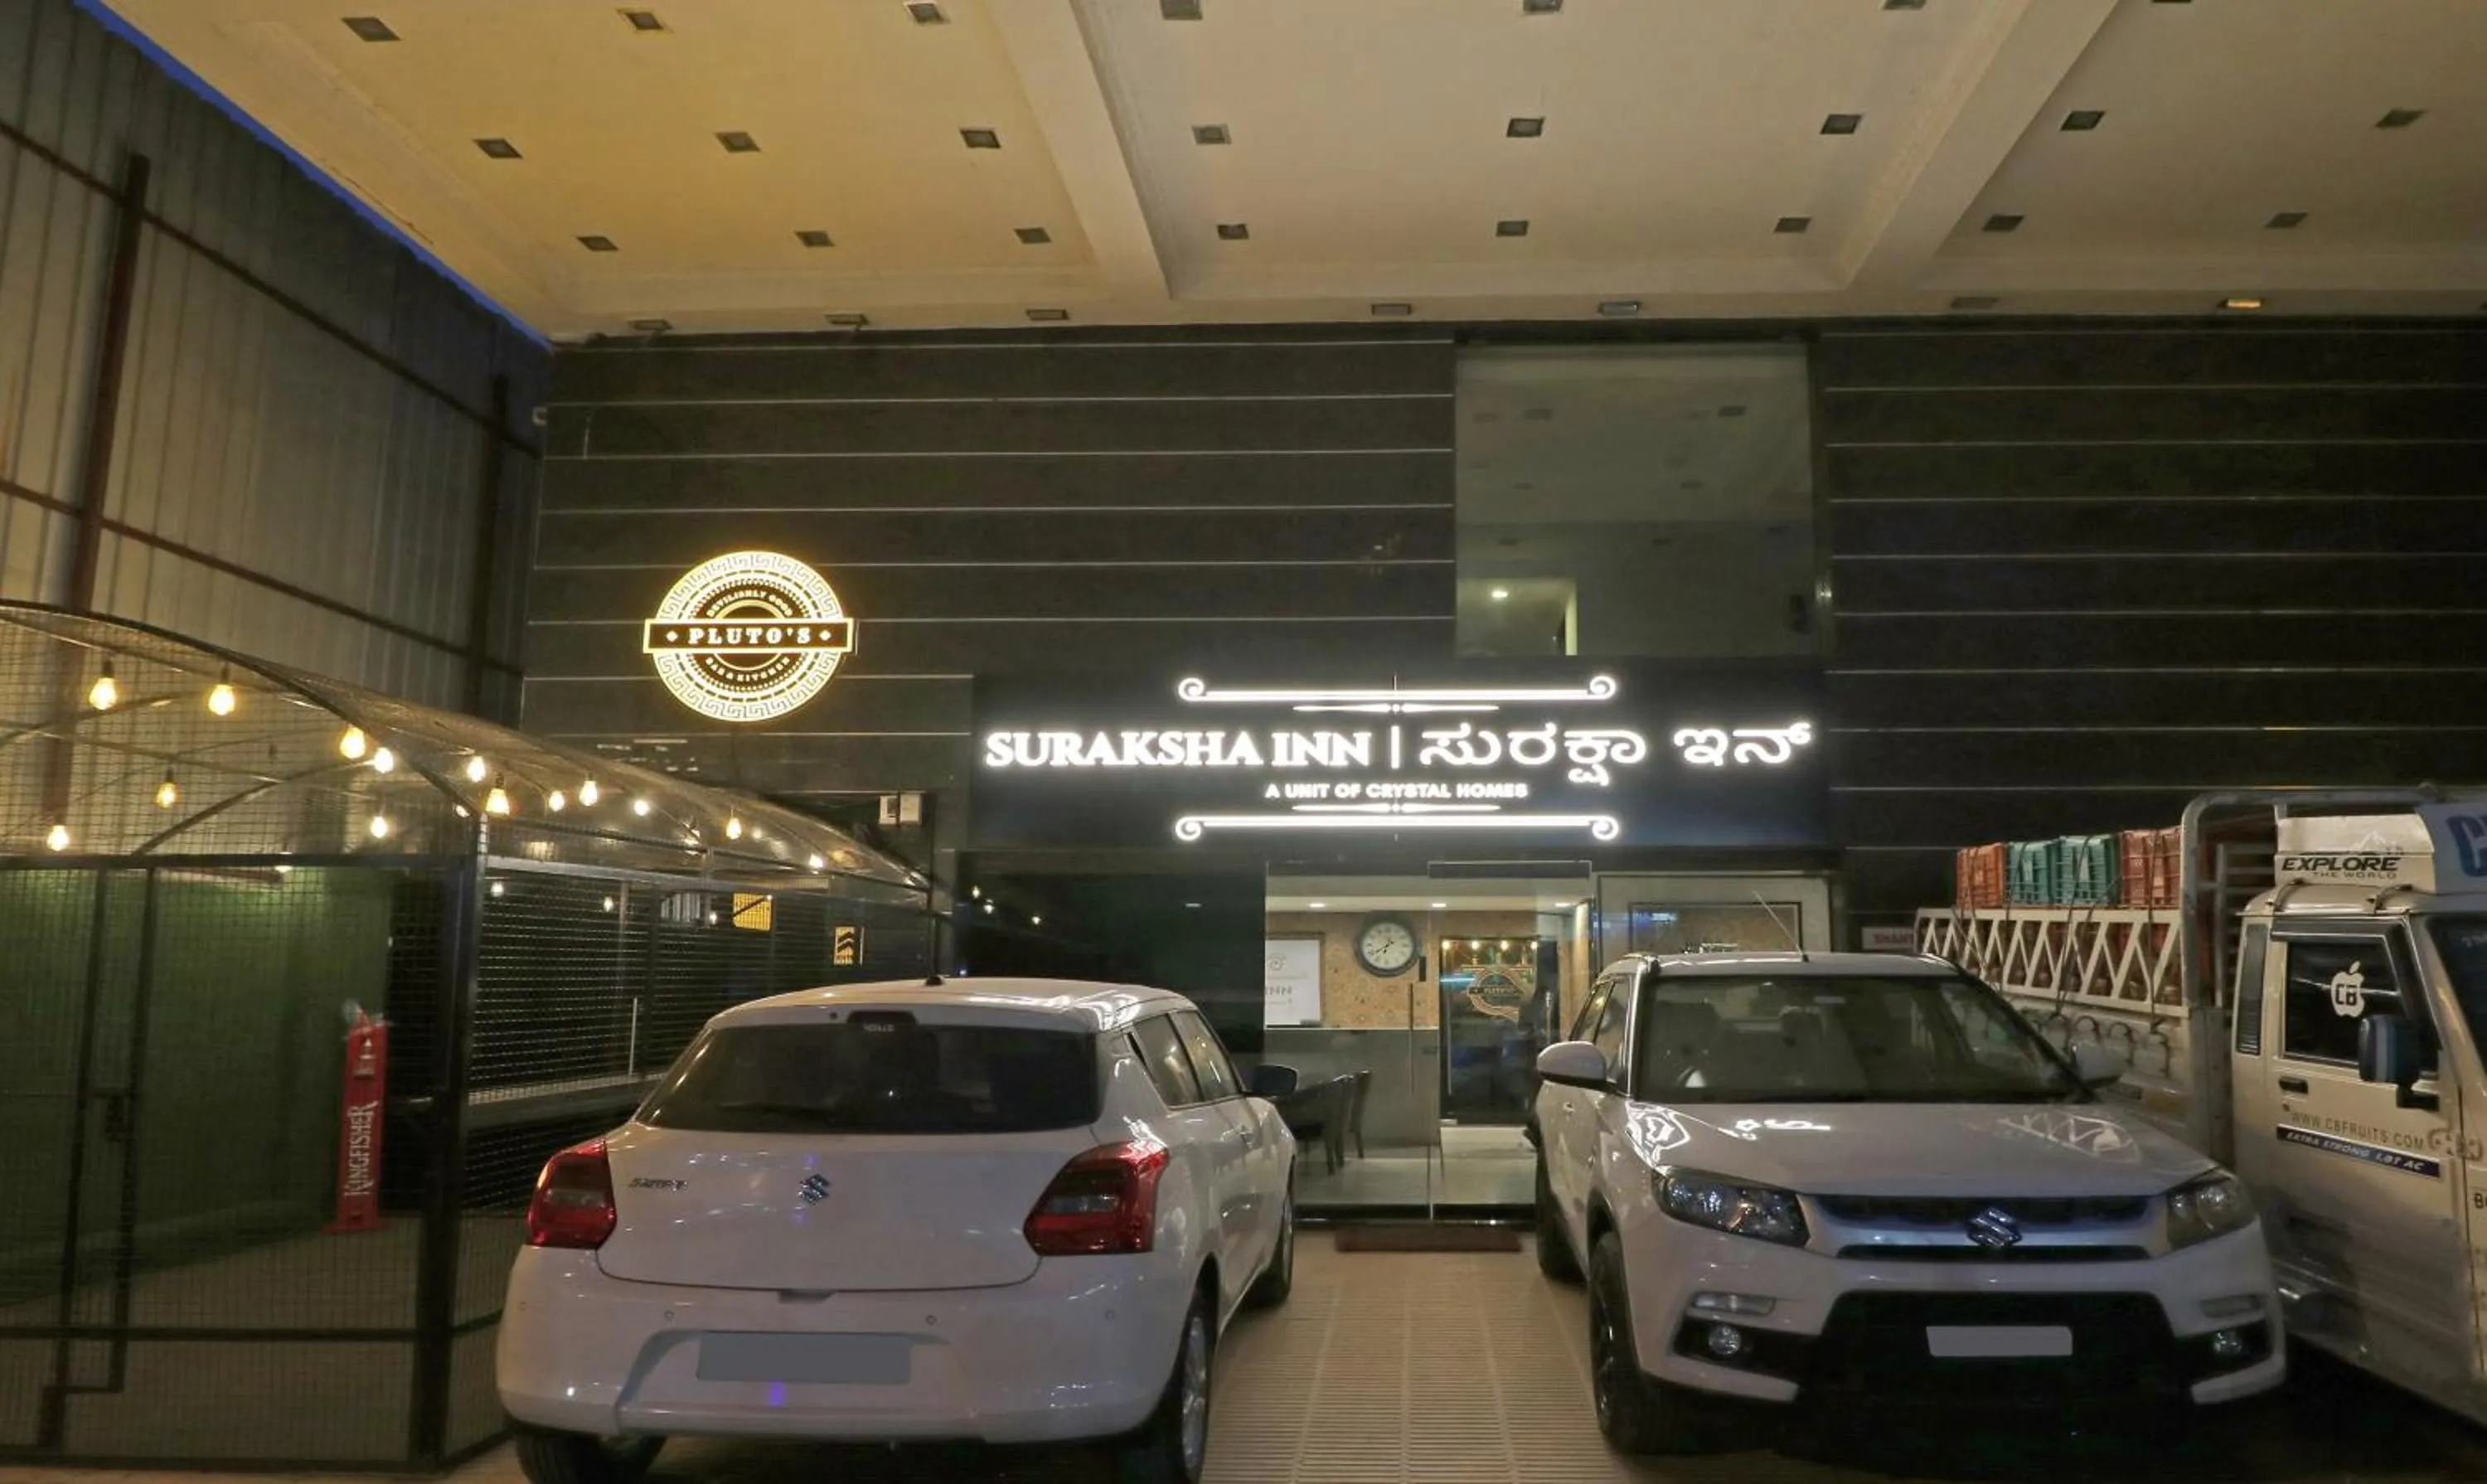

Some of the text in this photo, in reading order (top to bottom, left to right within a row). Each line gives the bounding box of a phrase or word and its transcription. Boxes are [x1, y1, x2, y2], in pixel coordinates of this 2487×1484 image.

[688, 628, 811, 644] PLUTO'S
[985, 730, 1372, 767] SURAKSHA INN
[1265, 783, 1530, 798] A UNIT OF CRYSTAL HOMES
[2281, 856, 2402, 871] EXPLORE
[2344, 871, 2397, 880] WORLD
[343, 1101, 380, 1196] KINGFISHER
